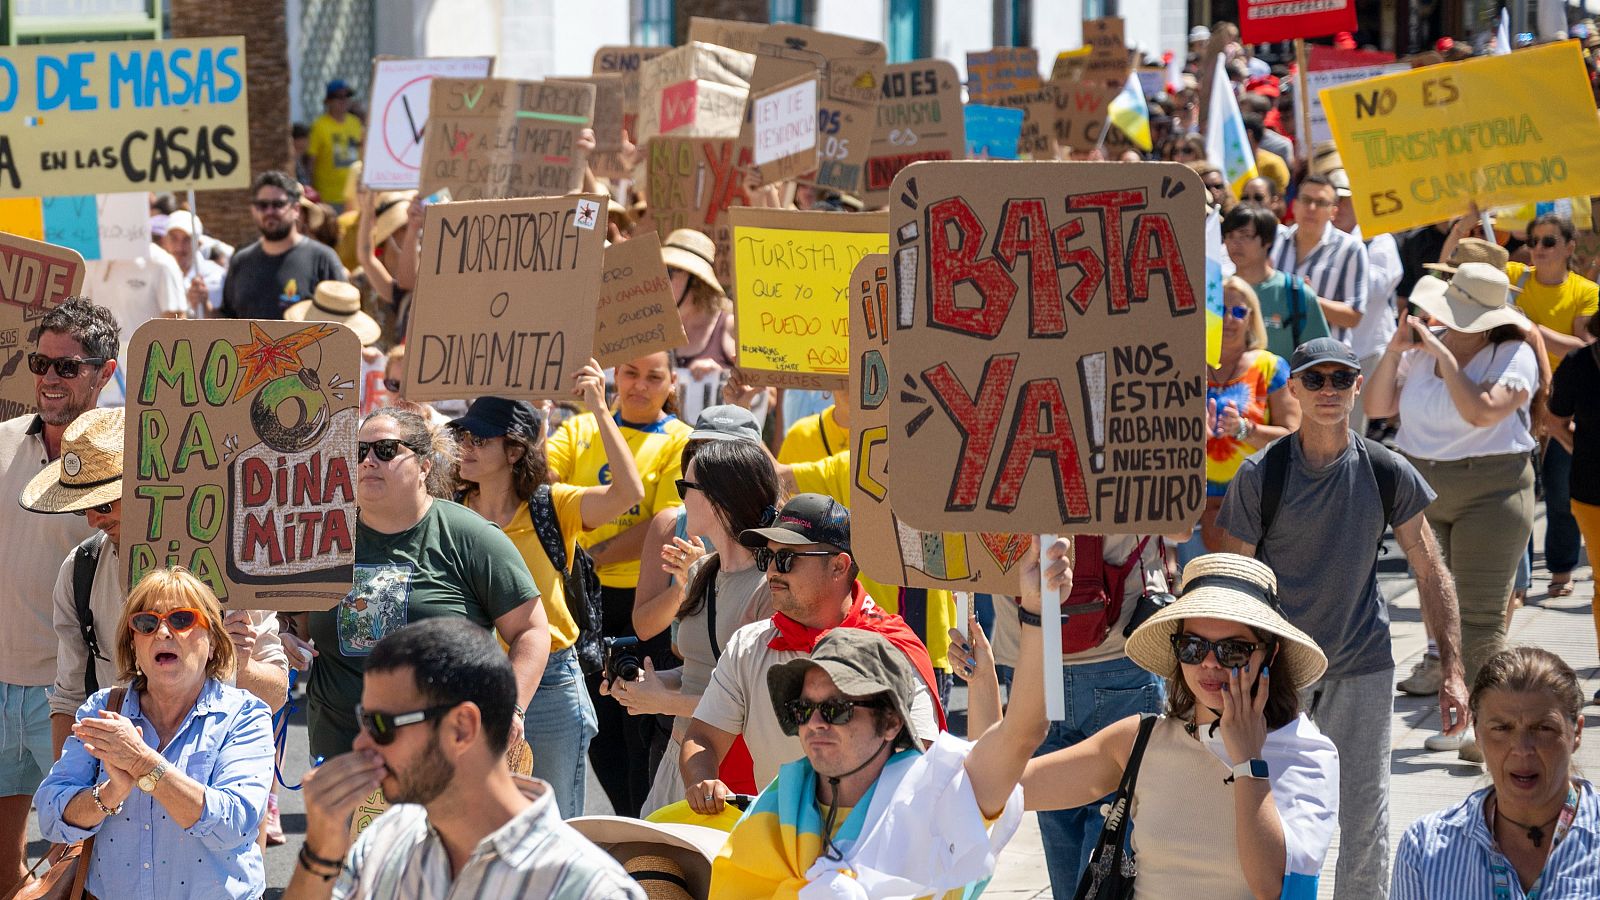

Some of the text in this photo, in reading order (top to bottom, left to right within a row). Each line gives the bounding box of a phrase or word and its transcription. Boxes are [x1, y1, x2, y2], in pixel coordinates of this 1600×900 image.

[37, 53, 97, 111] DE
[110, 48, 242, 109] MASAS
[911, 69, 937, 95] ES
[1355, 87, 1397, 118] NO
[1422, 77, 1460, 108] ES
[876, 100, 941, 127] TURISMO
[41, 150, 67, 171] EN
[75, 147, 118, 169] LAS
[121, 125, 240, 183] CASAS
[817, 136, 849, 158] OS
[1351, 112, 1543, 170] TURISMOFOBIA
[1370, 189, 1404, 217] ES
[435, 208, 581, 275] MORATORIA
[738, 236, 842, 276] TURISTA,
[894, 187, 1197, 339] ¡BASTA
[490, 291, 509, 318] O
[752, 278, 783, 298] QUE
[794, 284, 813, 301] YO
[617, 303, 665, 325] QUEDAR
[760, 311, 822, 337] PUEDO
[138, 339, 238, 407] MO
[417, 329, 565, 391] DINAMITA
[1113, 343, 1173, 377] NOS
[767, 374, 822, 388] SUELTES
[136, 409, 219, 481] RA
[921, 351, 1107, 525] YA!
[1109, 415, 1204, 444] ROBANDO
[1112, 447, 1203, 472] NUESTRO
[135, 484, 225, 542] TO
[1096, 473, 1201, 524] FUTURO
